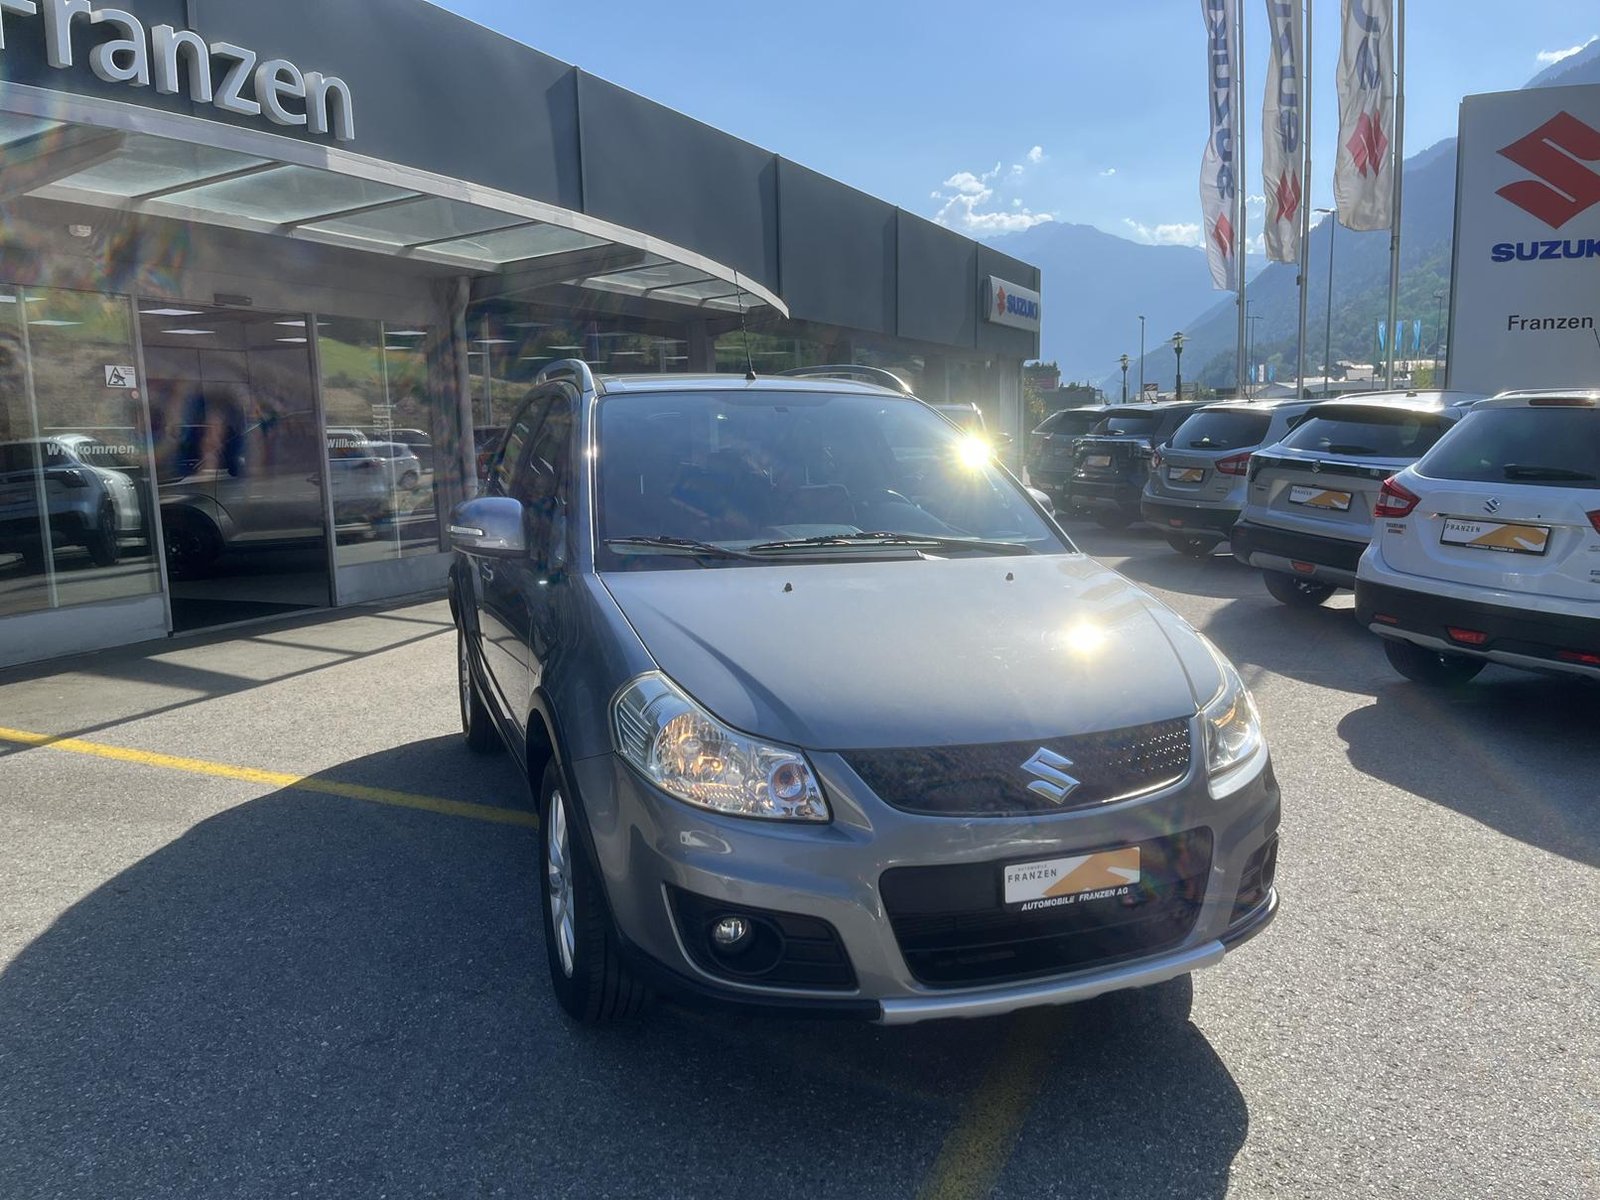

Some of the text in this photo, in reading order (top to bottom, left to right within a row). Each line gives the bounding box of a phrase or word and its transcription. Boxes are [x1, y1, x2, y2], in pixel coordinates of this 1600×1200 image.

[1006, 293, 1038, 320] SUZUKI
[1508, 314, 1594, 331] Franzen
[46, 443, 135, 456] Wikommen
[326, 438, 383, 449] Willko
[1445, 523, 1481, 533] FRANZEN
[1008, 870, 1057, 882] FRANZEN
[1021, 887, 1129, 911] AUTOMOBILE FRANZEN AG
